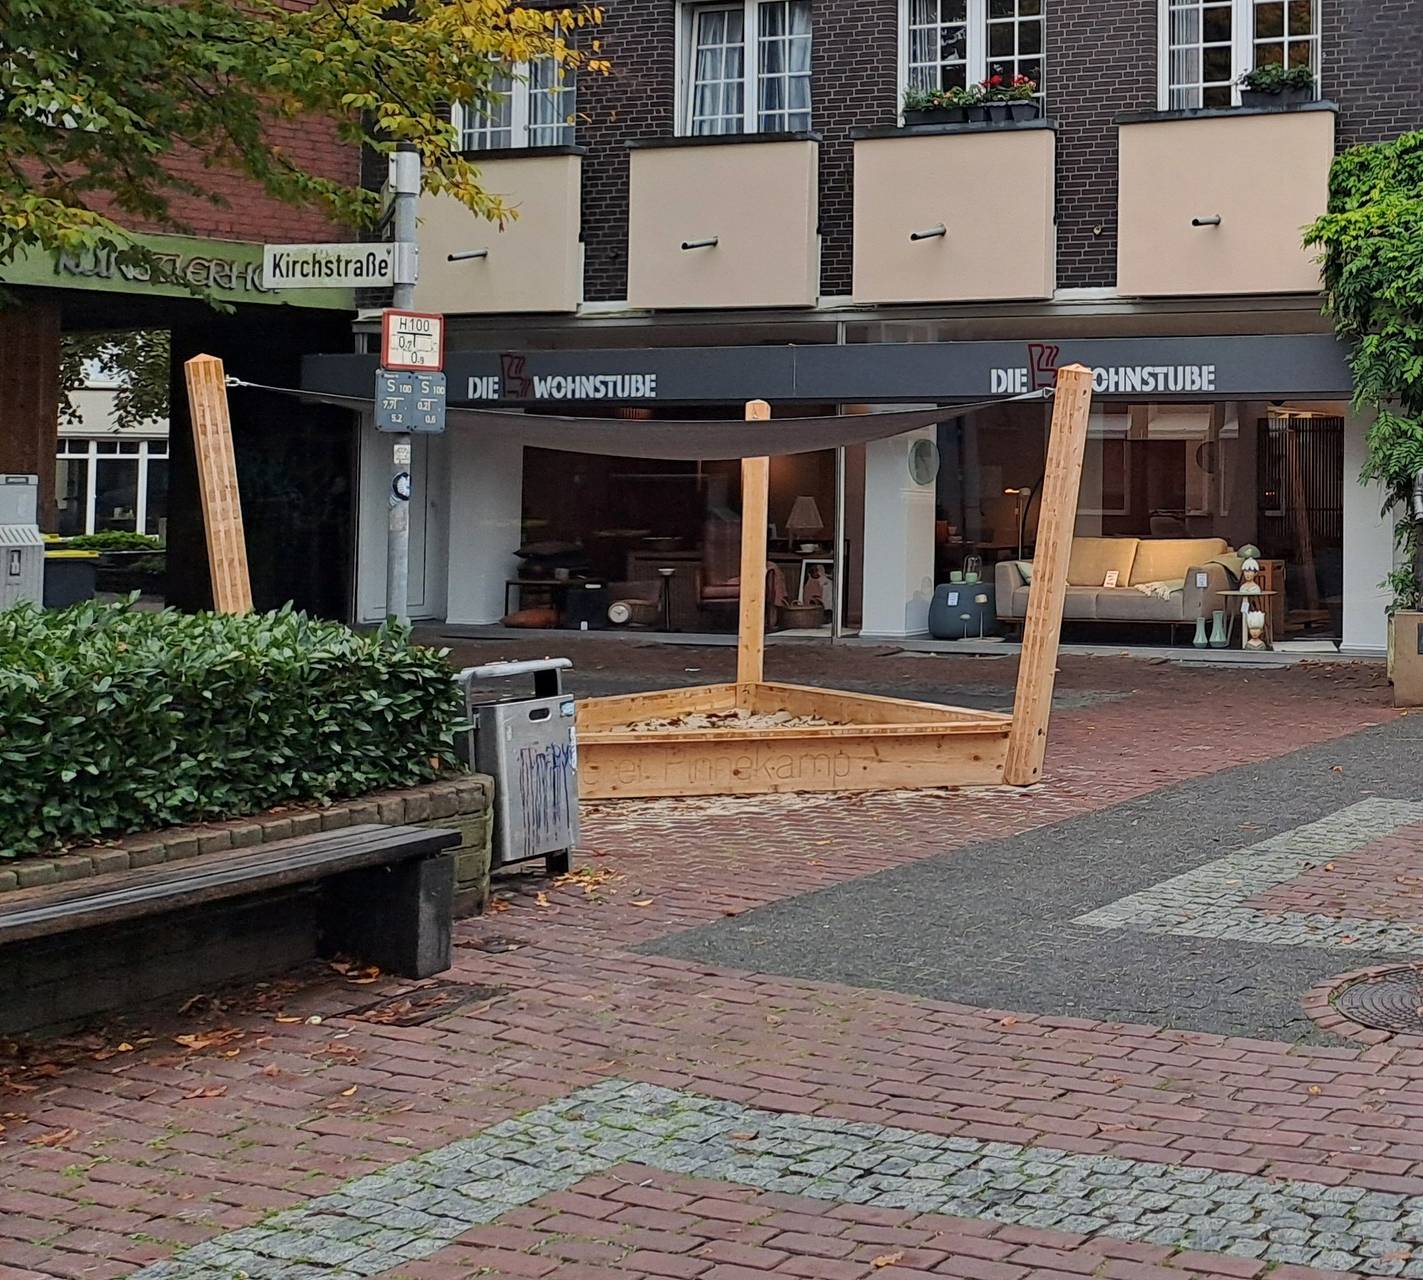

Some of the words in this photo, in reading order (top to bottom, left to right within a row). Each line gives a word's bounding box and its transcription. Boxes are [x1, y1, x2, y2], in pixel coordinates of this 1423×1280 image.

[272, 252, 389, 279] Kirchstraße
[386, 379, 396, 392] S
[399, 384, 412, 394] 100
[421, 381, 430, 394] S
[433, 386, 445, 395] 100
[468, 376, 500, 399] DIE
[533, 374, 657, 399] WOHNSTUBE
[990, 368, 1028, 393] DIE
[1089, 364, 1216, 393] OHNSTUBE
